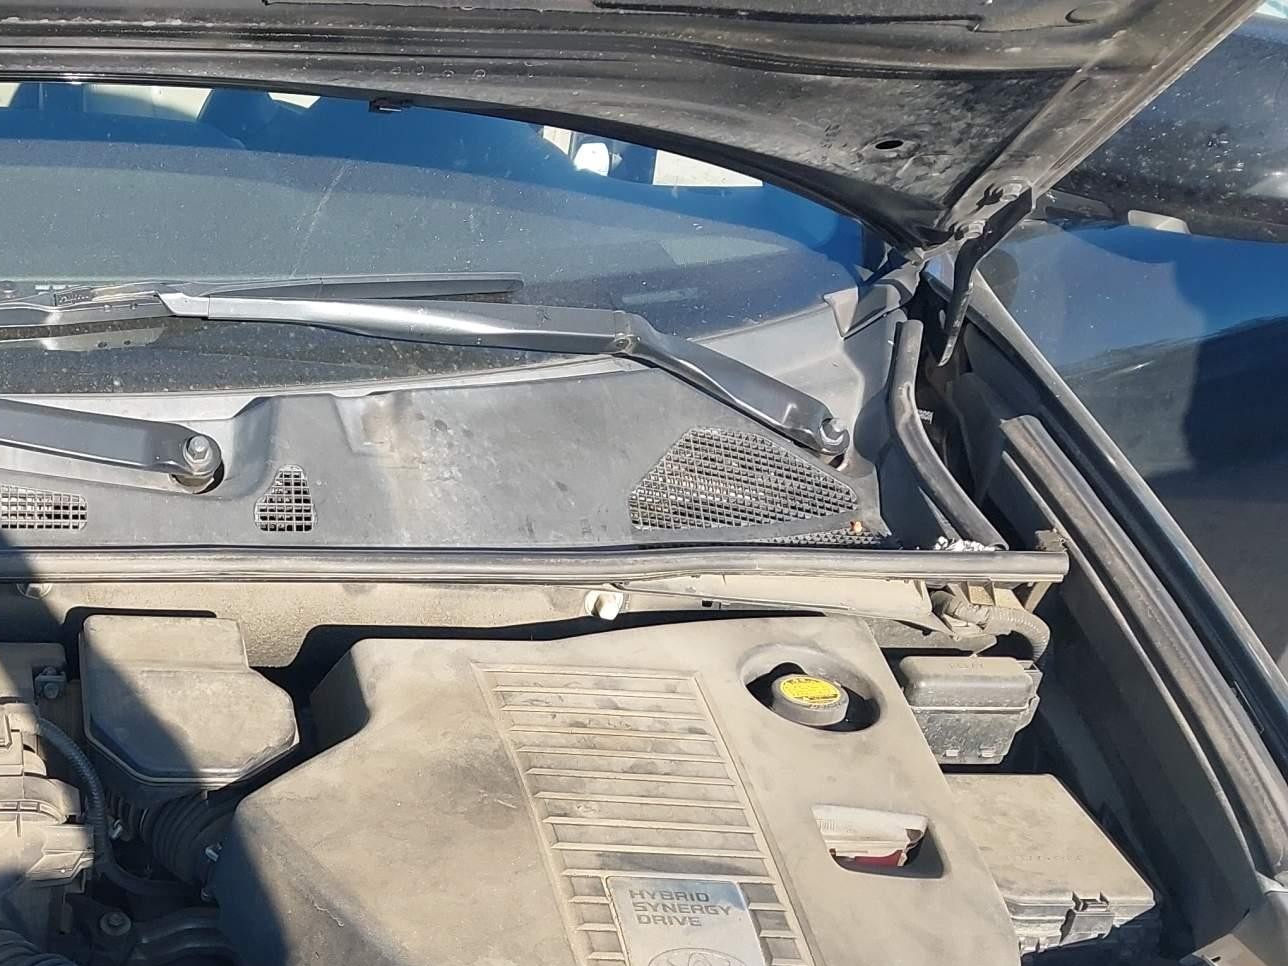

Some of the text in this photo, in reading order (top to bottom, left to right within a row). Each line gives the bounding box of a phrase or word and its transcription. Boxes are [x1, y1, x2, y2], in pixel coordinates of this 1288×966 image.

[628, 888, 710, 903] HYBRID
[632, 901, 732, 916] SYNERGY
[637, 914, 703, 927] DRIVE
